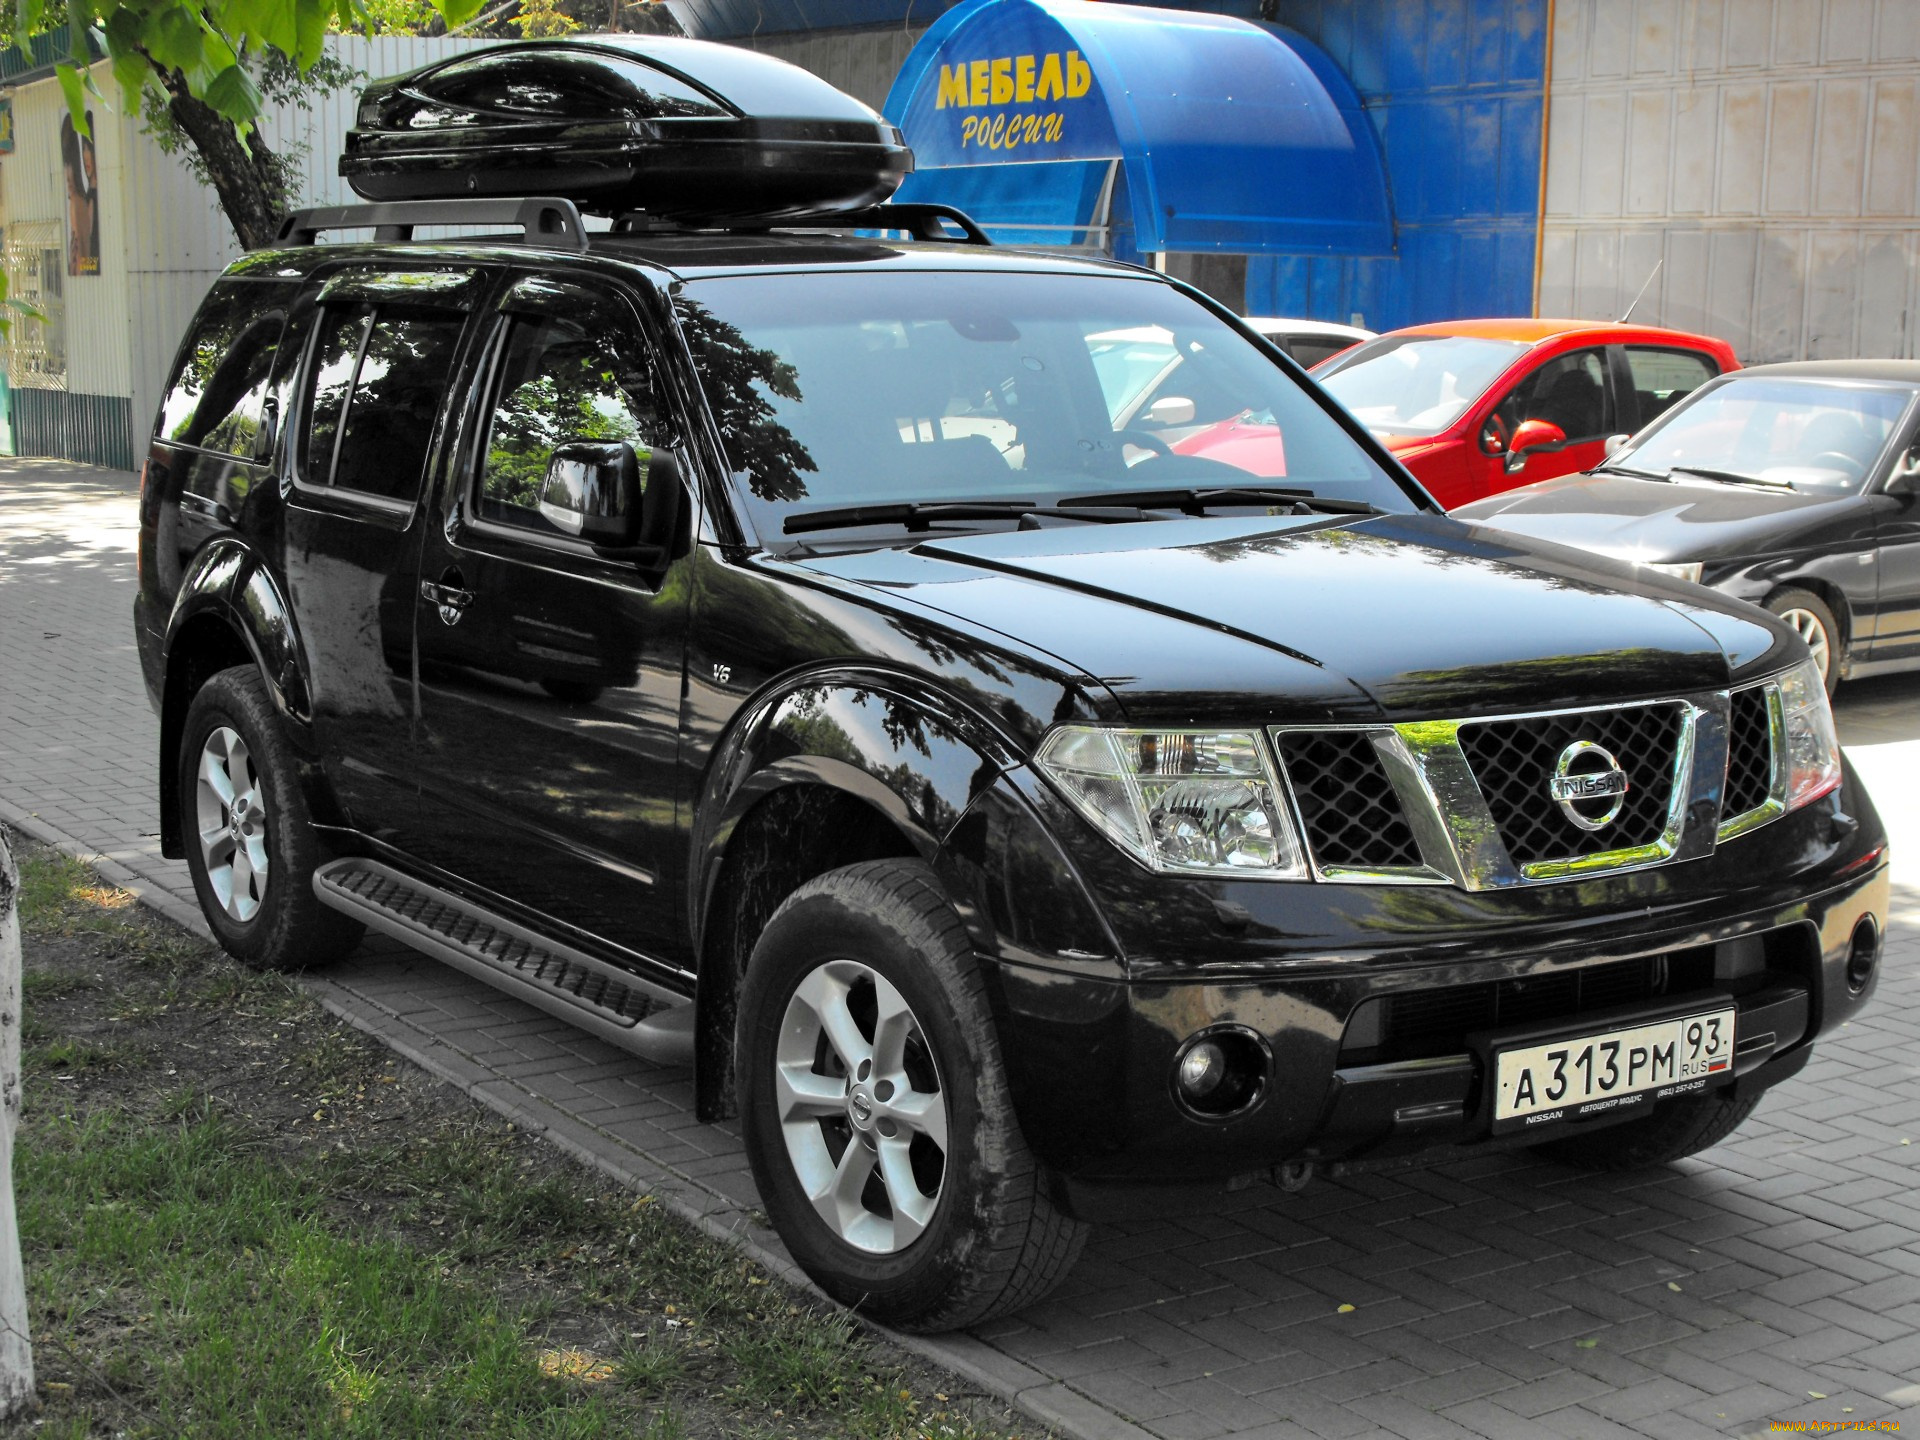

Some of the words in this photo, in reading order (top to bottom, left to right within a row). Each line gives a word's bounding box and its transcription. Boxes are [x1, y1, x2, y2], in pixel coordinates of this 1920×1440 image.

[935, 51, 1091, 110] МЕБЕЛЬ
[961, 112, 1064, 149] РОССИИ
[713, 663, 731, 684] V6
[1564, 775, 1625, 795] NISSAN
[1681, 1060, 1708, 1077] RUS
[1579, 1099, 1619, 1114] АВТОЦЕНТР
[1526, 1110, 1564, 1125] NISSAN
